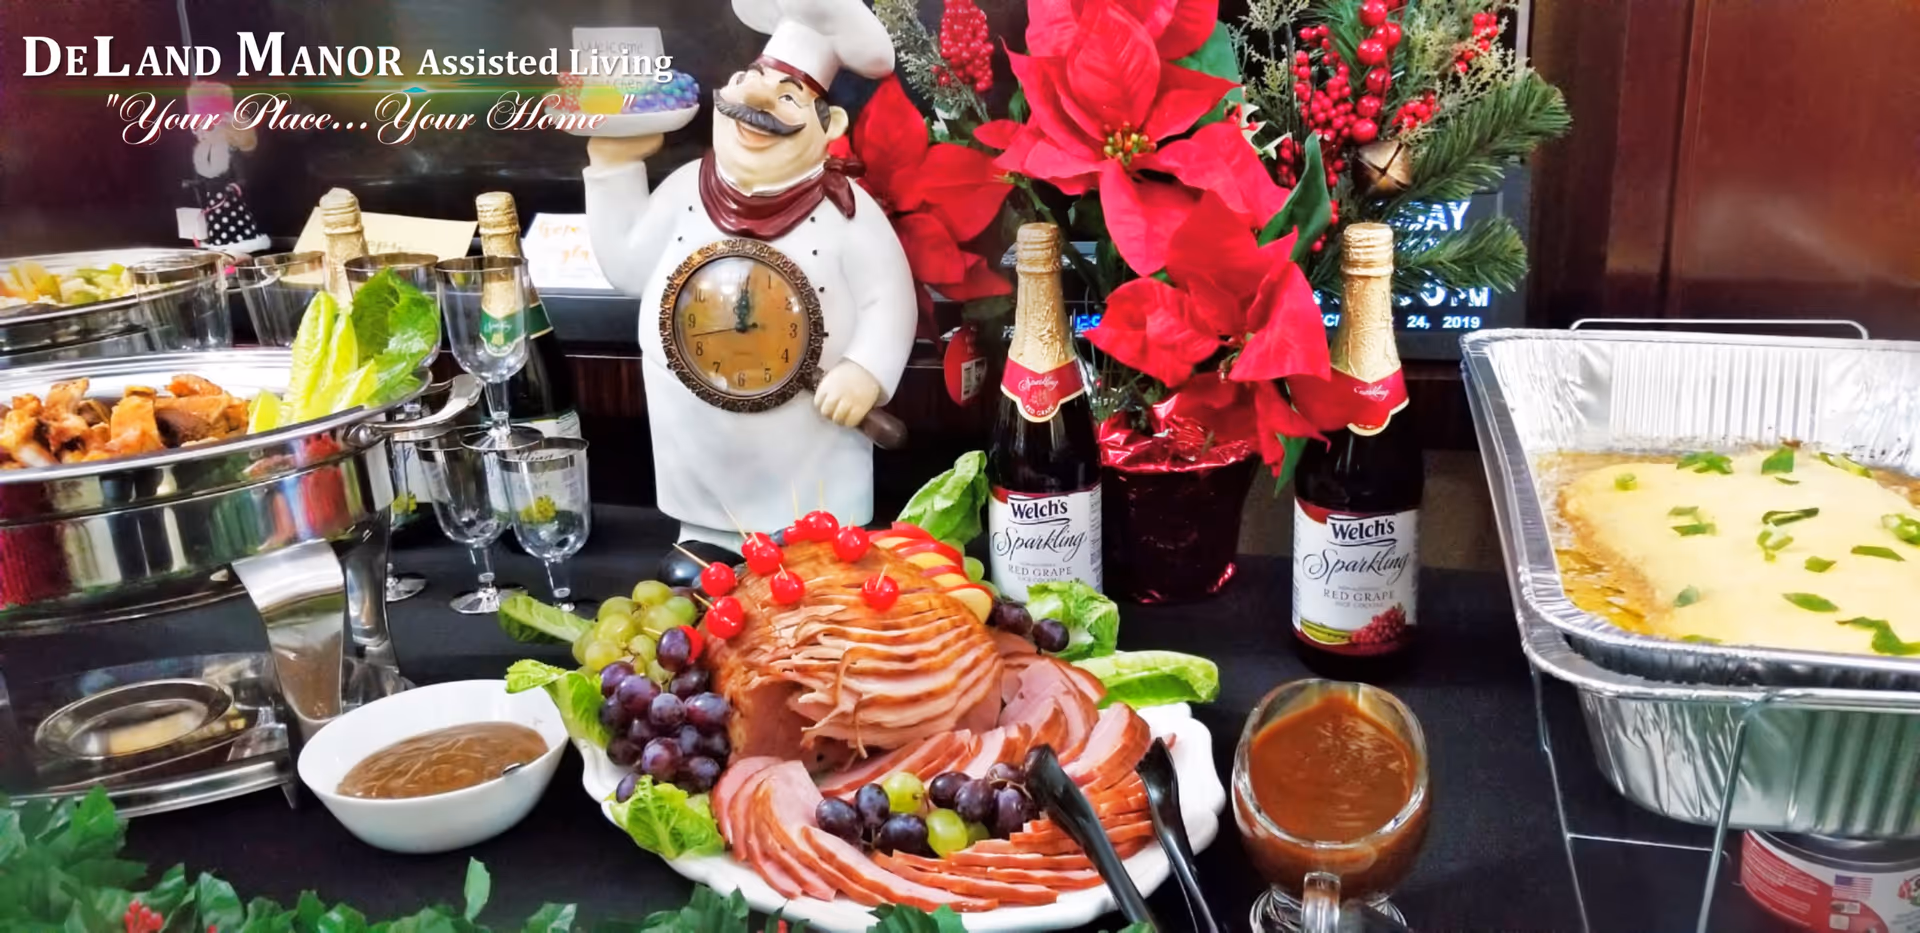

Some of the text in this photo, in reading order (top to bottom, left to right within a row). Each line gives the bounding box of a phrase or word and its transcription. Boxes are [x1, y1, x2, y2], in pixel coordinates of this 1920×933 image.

[688, 313, 696, 328] 9
[1442, 316, 1481, 329] 2019
[789, 322, 798, 339] 3
[695, 341, 704, 356] 8
[781, 348, 789, 363] 4
[713, 361, 721, 375] 7
[764, 368, 772, 383] 5
[737, 372, 745, 387] 6
[1010, 500, 1068, 519] Welch's
[1330, 518, 1395, 540] Welch's
[992, 524, 1087, 562] Sparkling
[1008, 564, 1029, 576] RED
[1033, 566, 1072, 577] GRAPE
[1302, 545, 1410, 585] Sparkling
[1323, 588, 1349, 600] RED
[1353, 590, 1395, 601] GRAPE
